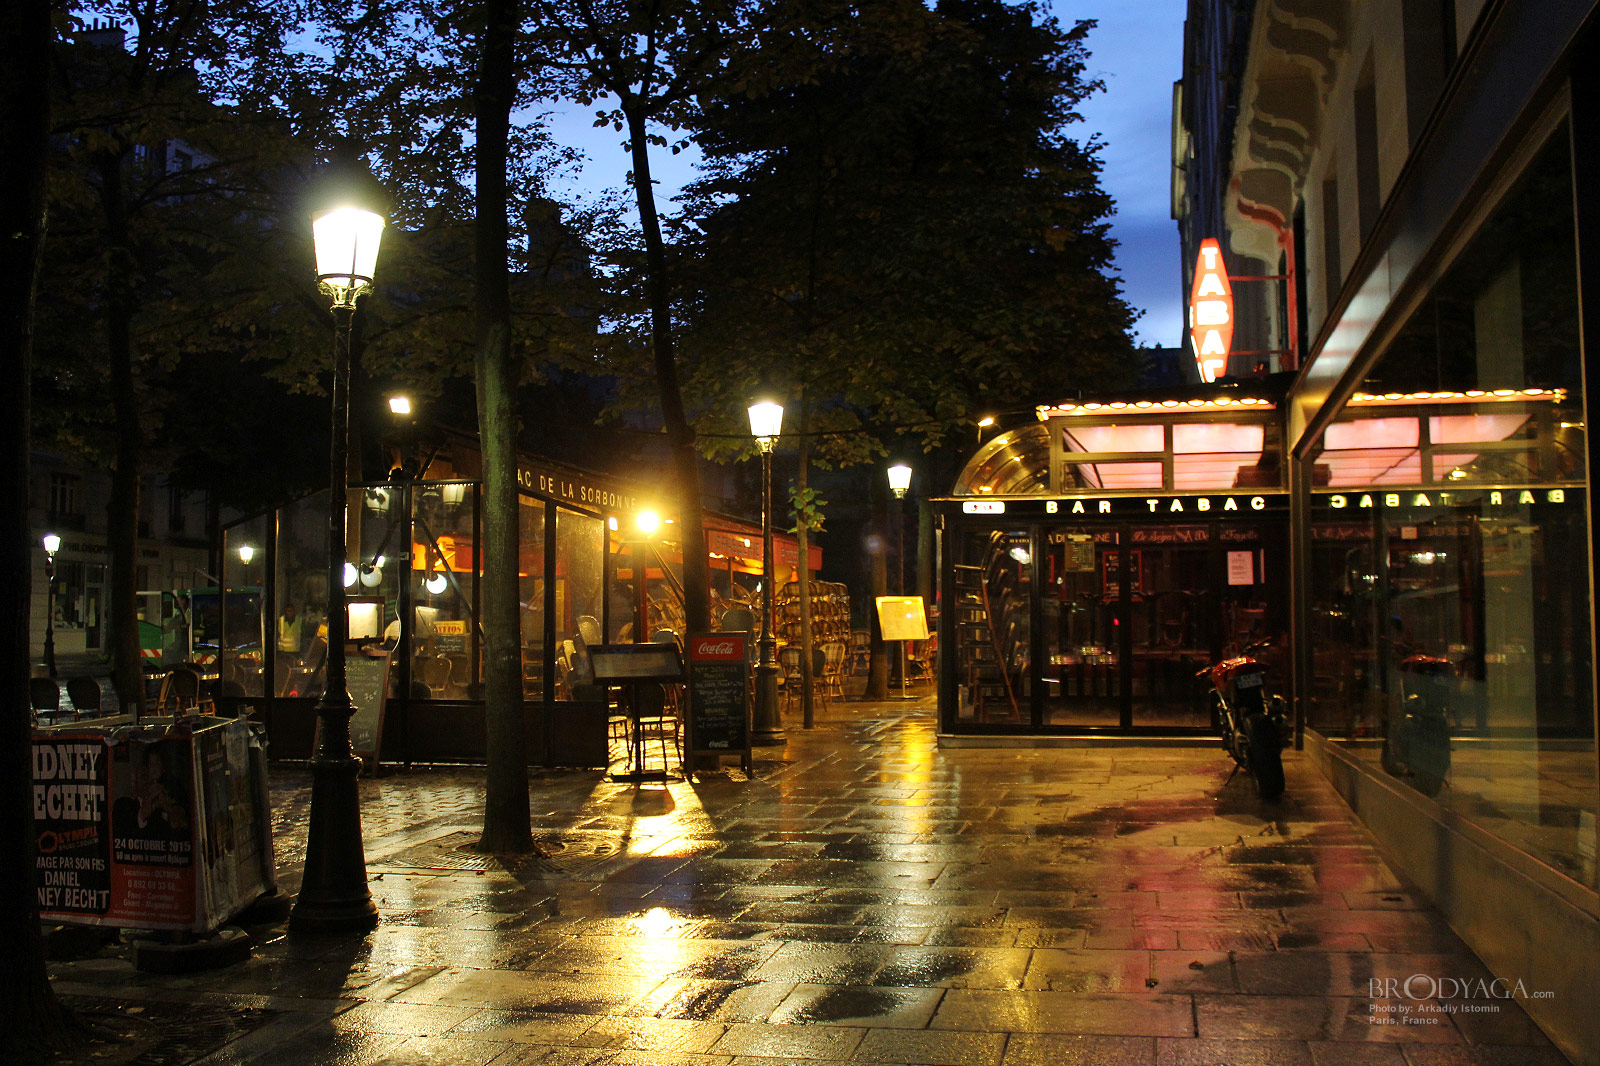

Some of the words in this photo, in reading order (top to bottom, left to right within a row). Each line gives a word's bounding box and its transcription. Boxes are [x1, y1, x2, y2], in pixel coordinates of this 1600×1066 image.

[1196, 246, 1230, 384] TABAC
[517, 468, 532, 488] AC
[539, 475, 554, 494] DE
[561, 481, 574, 499] LA
[580, 485, 637, 511] SORBONNE
[1045, 500, 1112, 514] BAR
[1146, 496, 1266, 513] TABAC
[698, 642, 735, 655] Coca-Cola
[32, 744, 102, 780] IDNEY
[33, 784, 105, 822] ECHET
[114, 838, 126, 849] 24
[128, 838, 167, 851] OCTOBRE
[169, 840, 191, 853] 2015
[75, 857, 90, 870] SON
[45, 871, 80, 887] DANIEL
[37, 887, 61, 907] NEY
